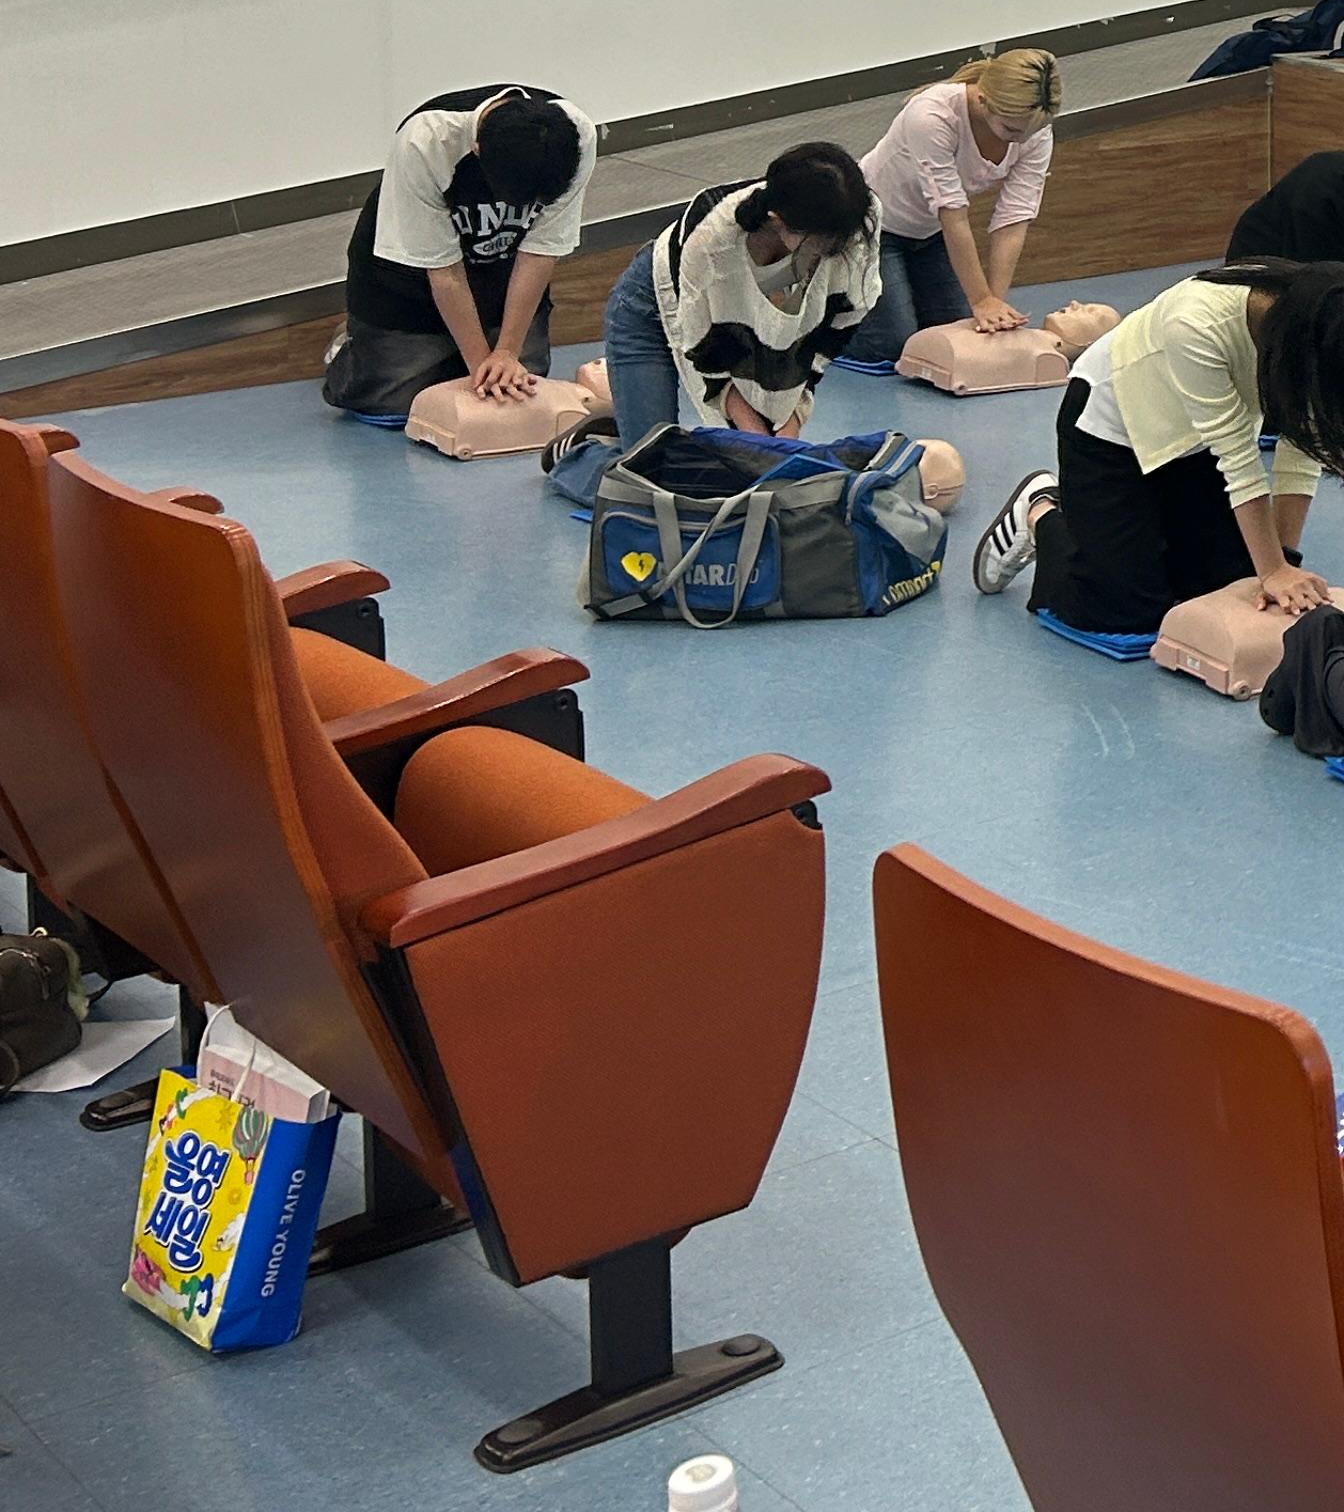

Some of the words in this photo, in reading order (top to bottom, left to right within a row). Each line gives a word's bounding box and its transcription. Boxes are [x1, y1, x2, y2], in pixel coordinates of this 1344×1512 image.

[144, 1191, 210, 1270] 세일
[280, 1170, 306, 1224] OLIVE
[261, 1230, 289, 1297] YOUNG
